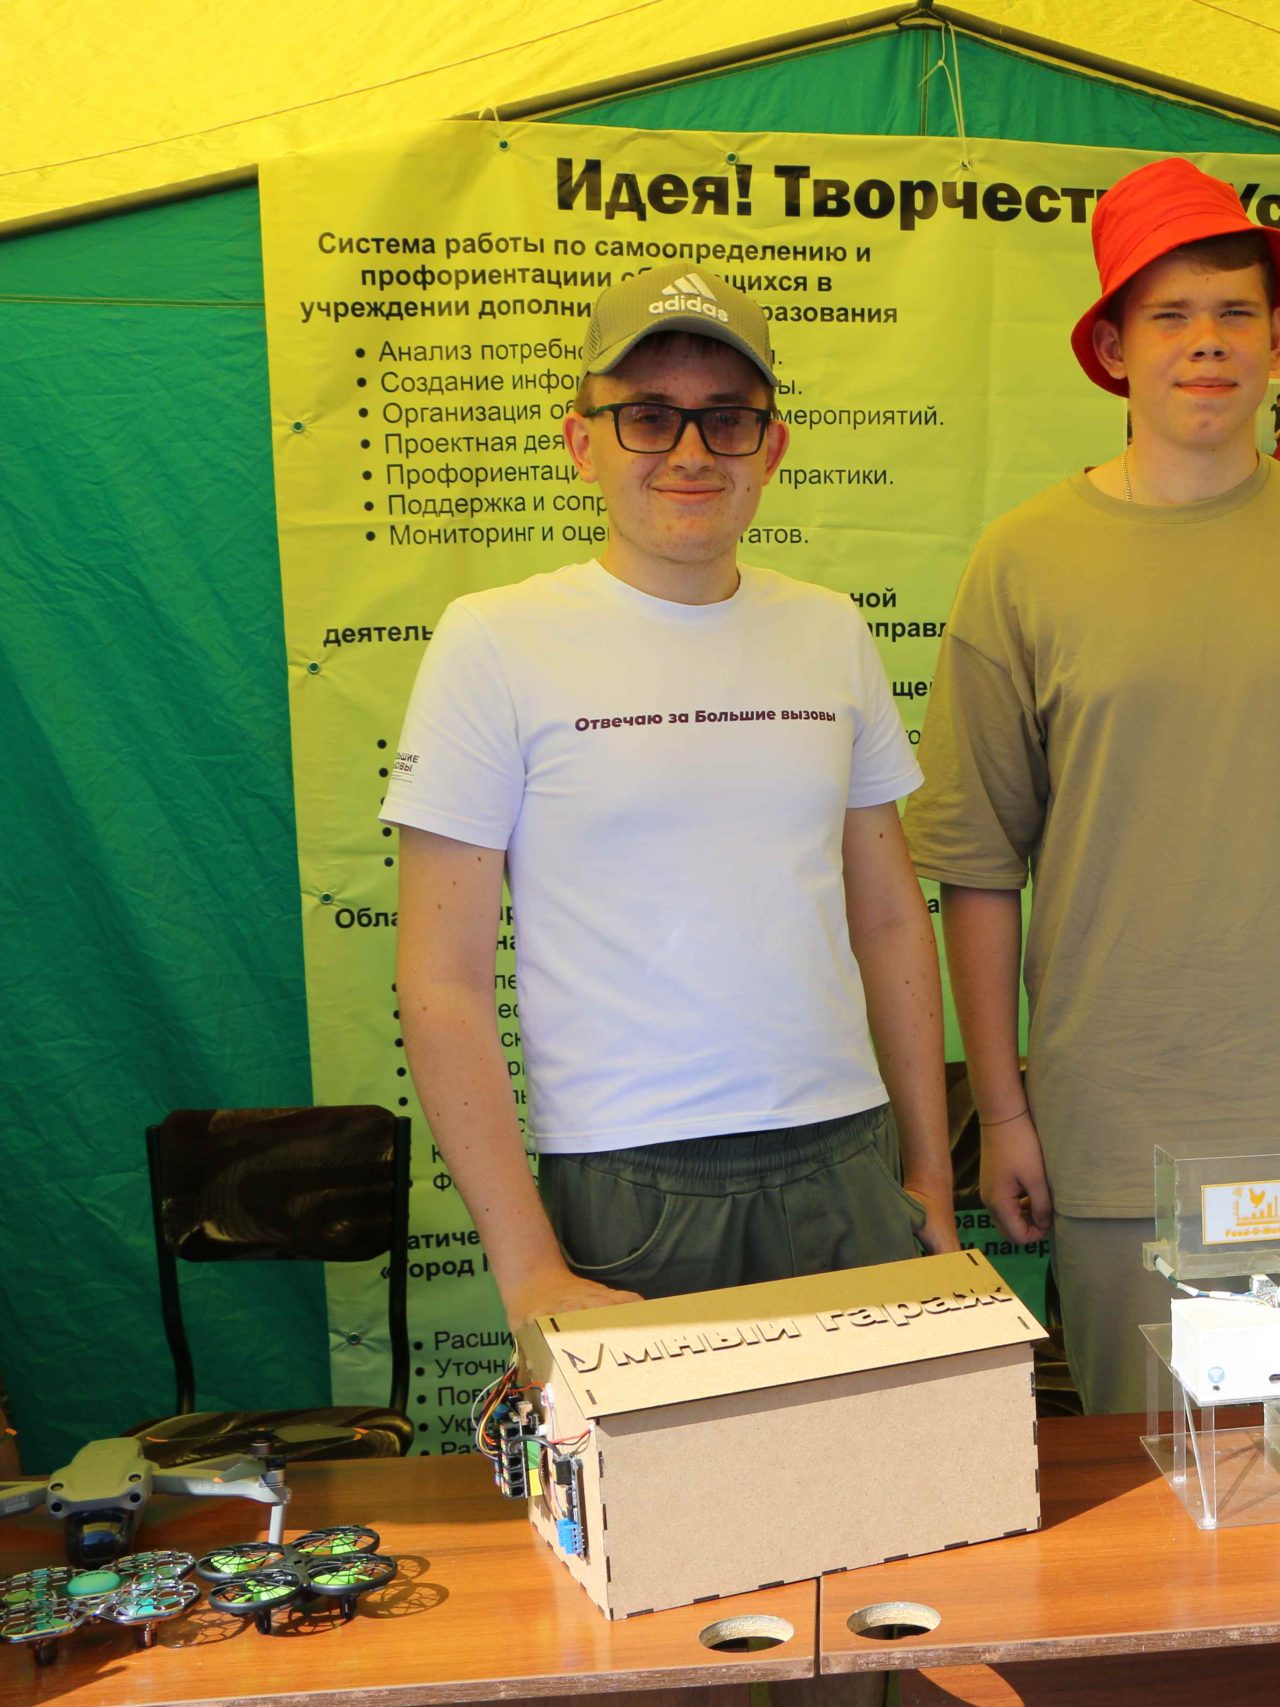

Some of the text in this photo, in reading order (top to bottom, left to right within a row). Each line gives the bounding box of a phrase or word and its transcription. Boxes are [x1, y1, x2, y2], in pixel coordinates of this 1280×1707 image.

[556, 157, 753, 222] Идея!
[773, 164, 1109, 231] Творчест
[317, 231, 872, 264] Система работы по самоопределению и
[360, 264, 612, 292] профориентациии
[817, 274, 833, 293] в
[300, 298, 898, 324] учреждении дополни разования
[648, 294, 730, 323] adidas
[378, 340, 473, 363] Анализ
[380, 371, 505, 395] Создание
[382, 401, 541, 428] Организация
[777, 405, 945, 431] мероприятий.
[384, 433, 565, 459] Проектная дея
[386, 462, 895, 490] Профориентаци практики.
[387, 493, 607, 518] Поддержка и сопр
[389, 524, 809, 548] Мониторинг и оце атов.
[850, 587, 897, 608] ной
[322, 625, 434, 648] деятель
[574, 709, 837, 732] Отвечаю за Большие вызовы
[334, 907, 399, 929] Обла
[984, 1240, 1051, 1258] лагер
[814, 1284, 1014, 1335] гараж
[433, 1330, 514, 1351] Расши
[434, 1357, 507, 1379] Уточн
